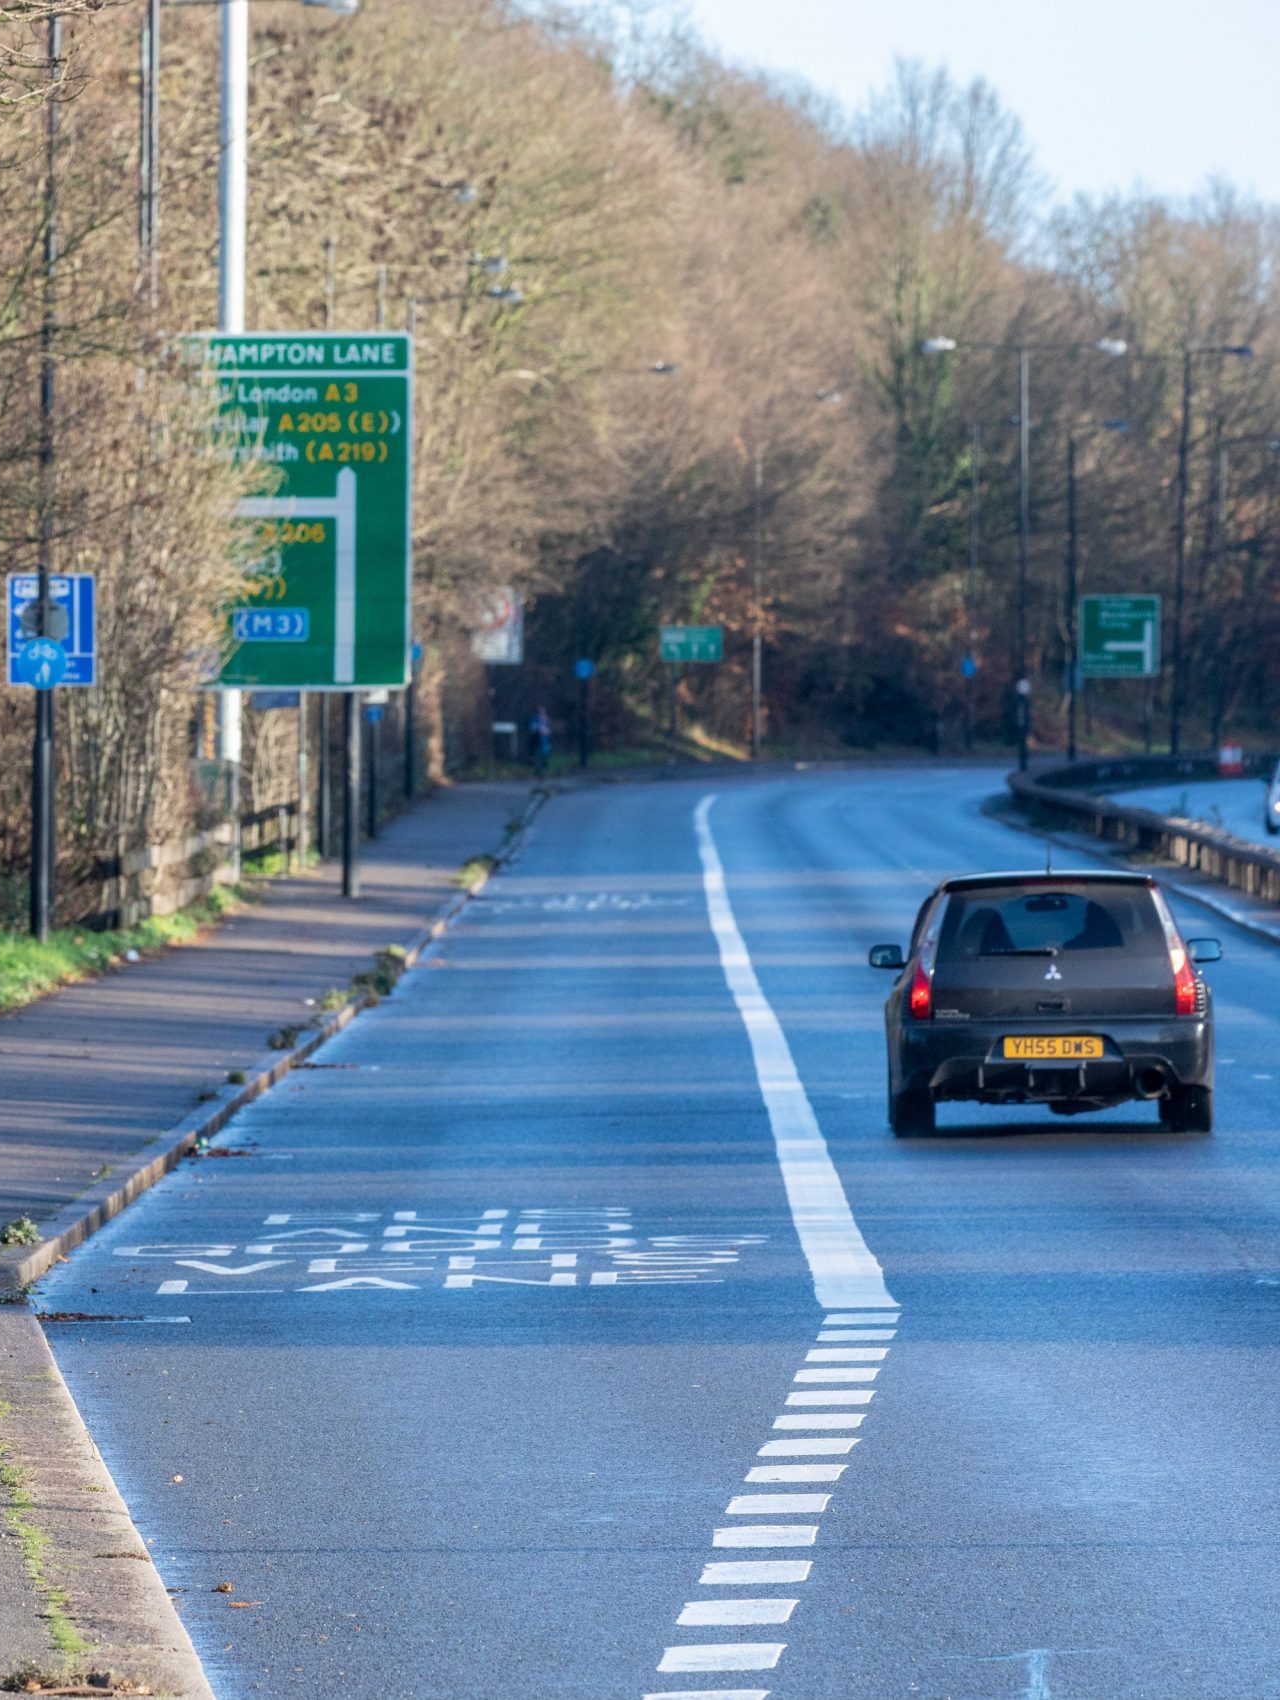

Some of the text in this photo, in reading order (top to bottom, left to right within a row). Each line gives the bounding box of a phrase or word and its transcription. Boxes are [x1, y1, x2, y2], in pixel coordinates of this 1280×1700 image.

[190, 342, 396, 365] HAMPTON LANE
[237, 384, 319, 404] London
[278, 412, 341, 433] A205
[305, 440, 389, 464] (A219)
[1012, 1039, 1058, 1055] YH55
[262, 1206, 633, 1226] BUS
[255, 1221, 635, 1240] AND
[111, 1233, 771, 1258] GOODS
[154, 1268, 725, 1295] LANE
